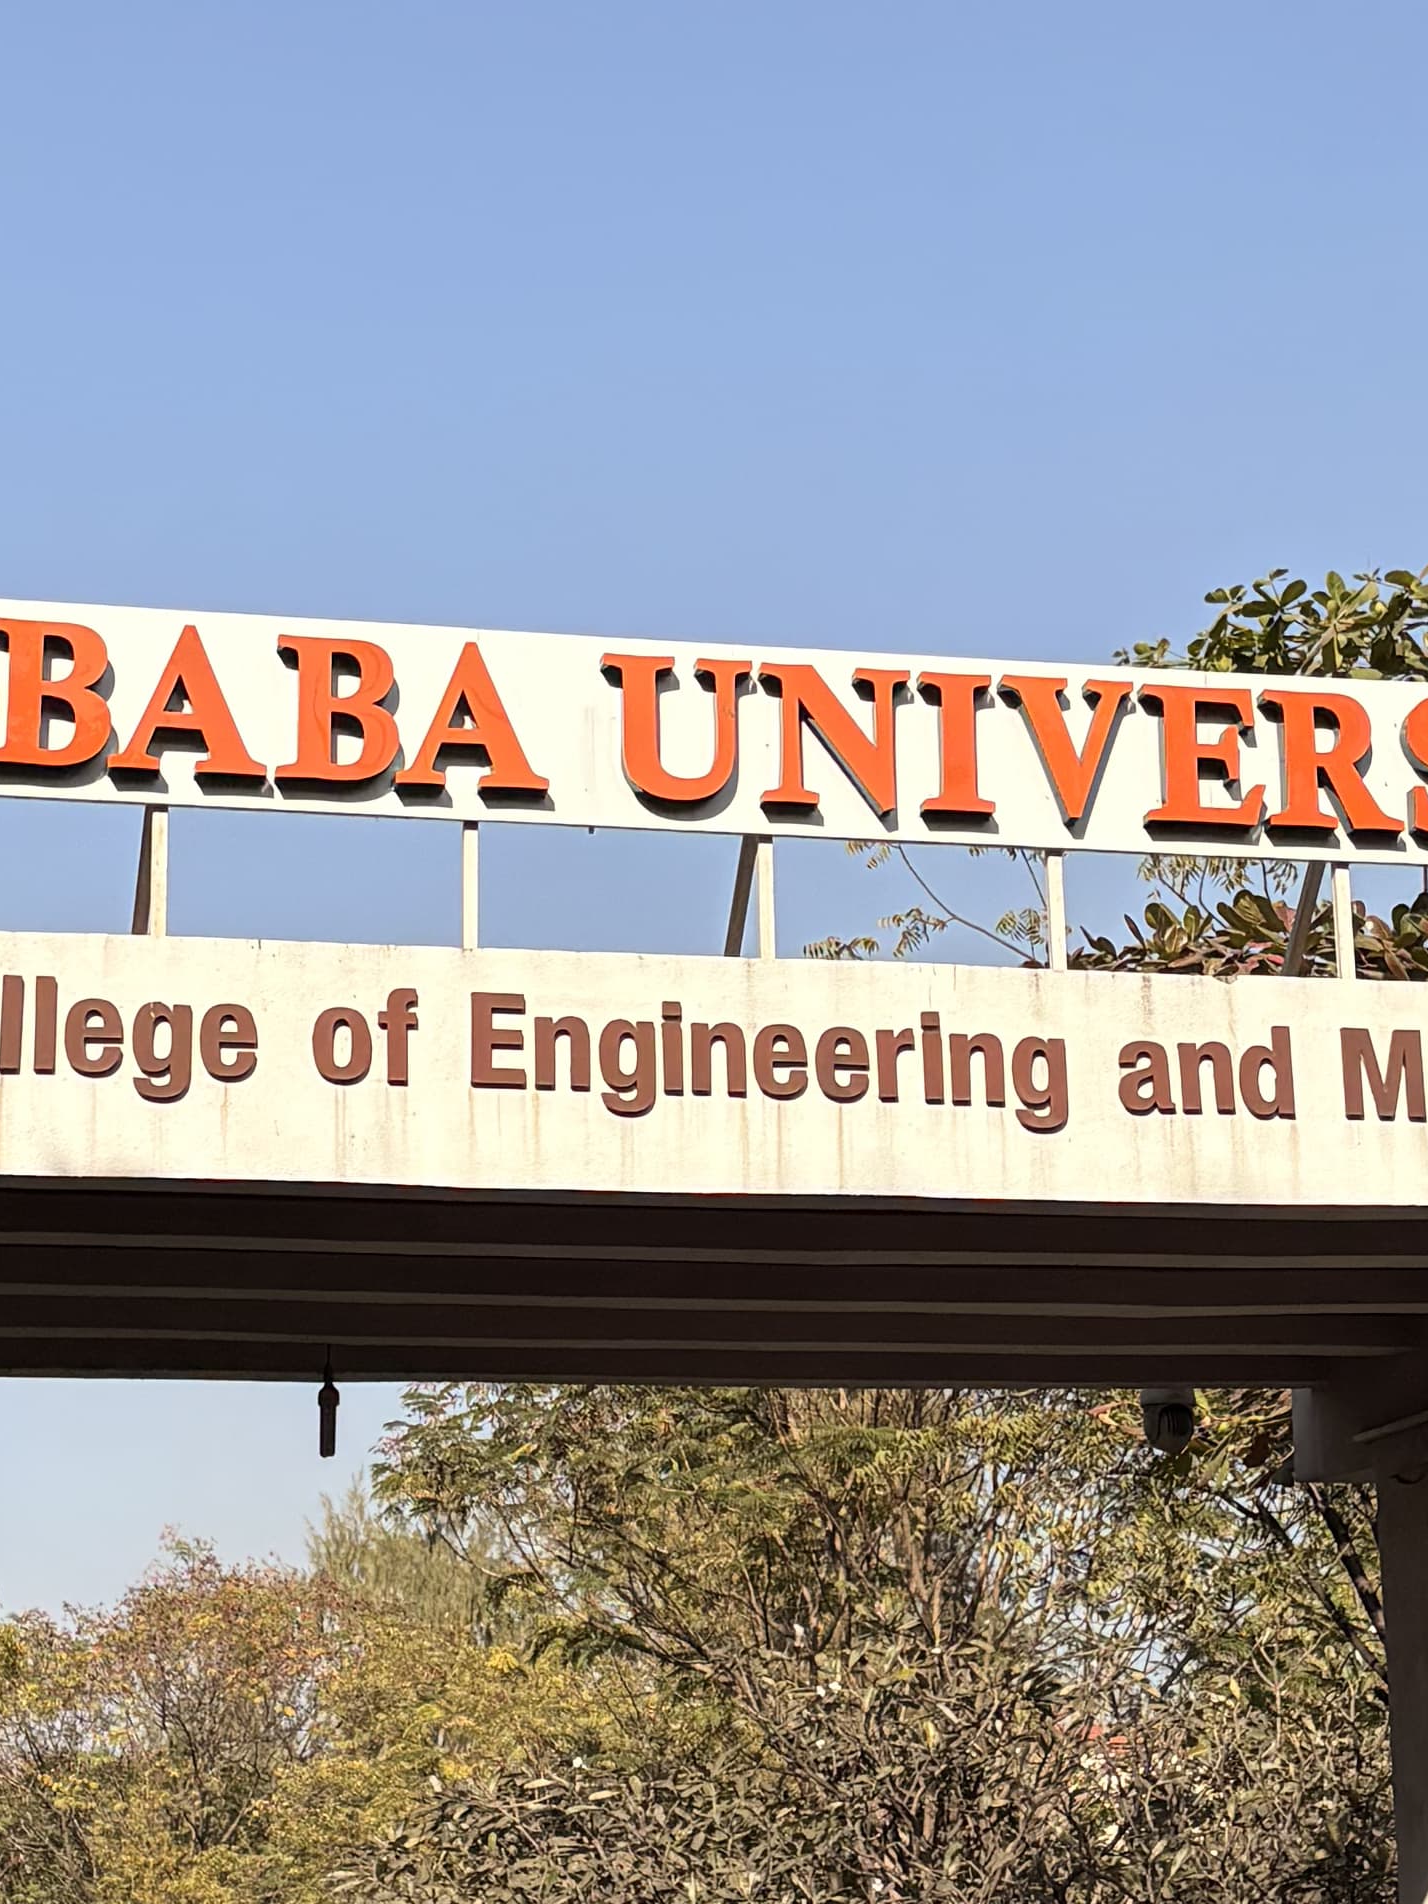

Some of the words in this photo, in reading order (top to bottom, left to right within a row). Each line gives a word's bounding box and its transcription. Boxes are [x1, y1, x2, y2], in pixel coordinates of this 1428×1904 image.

[312, 987, 419, 1086] of
[471, 991, 1069, 1132] Engineering
[1117, 1025, 1295, 1122] and
